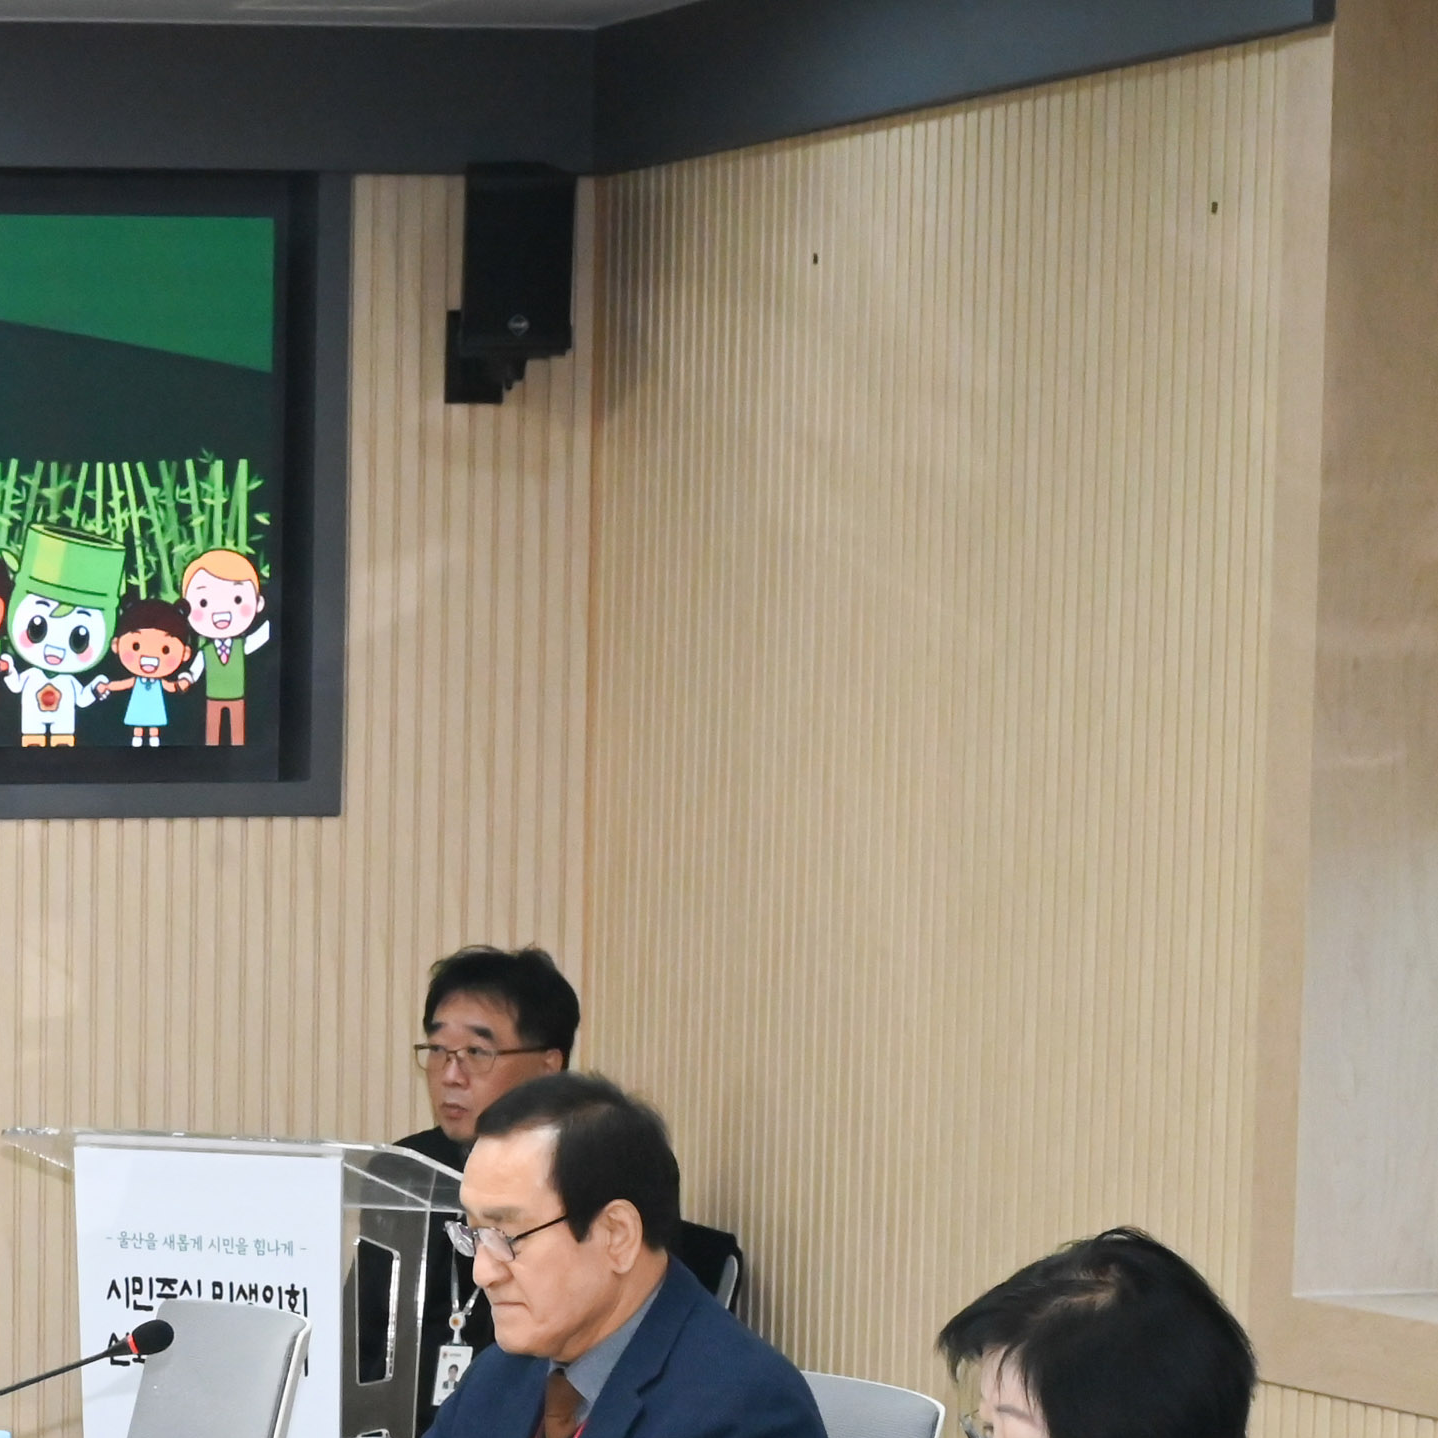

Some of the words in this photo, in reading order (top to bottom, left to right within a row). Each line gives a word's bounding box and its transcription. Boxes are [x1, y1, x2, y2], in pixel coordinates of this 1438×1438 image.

[116, 1231, 158, 1250] 울산을
[162, 1234, 204, 1252] 새롭게
[208, 1238, 249, 1256] 시민을
[253, 1239, 294, 1258] 힘나게
